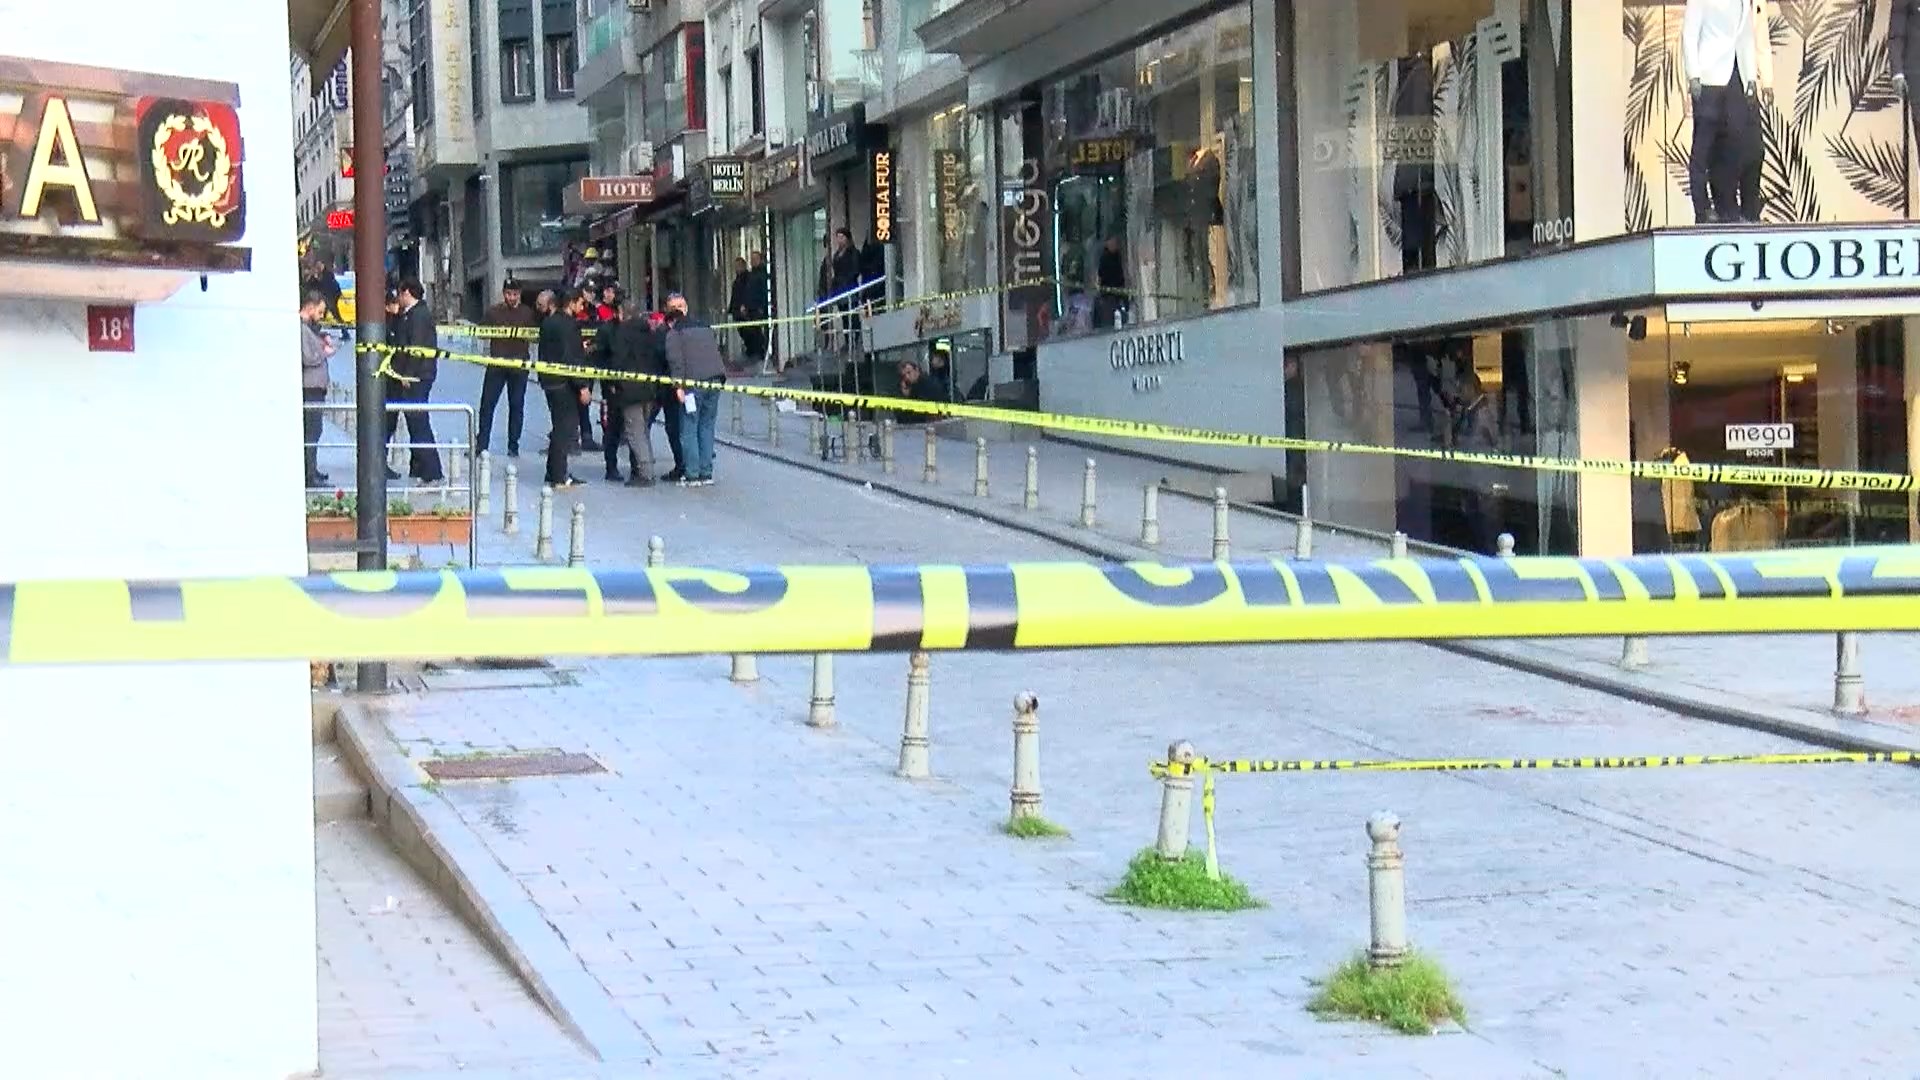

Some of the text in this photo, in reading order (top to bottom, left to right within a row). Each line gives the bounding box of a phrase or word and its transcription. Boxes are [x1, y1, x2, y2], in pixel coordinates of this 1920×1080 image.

[713, 163, 743, 176] HOTEL
[876, 151, 891, 241] SOFIA FUR
[1533, 216, 1573, 247] mega
[1110, 331, 1184, 370] GIOBERTI
[1728, 427, 1791, 446] mega
